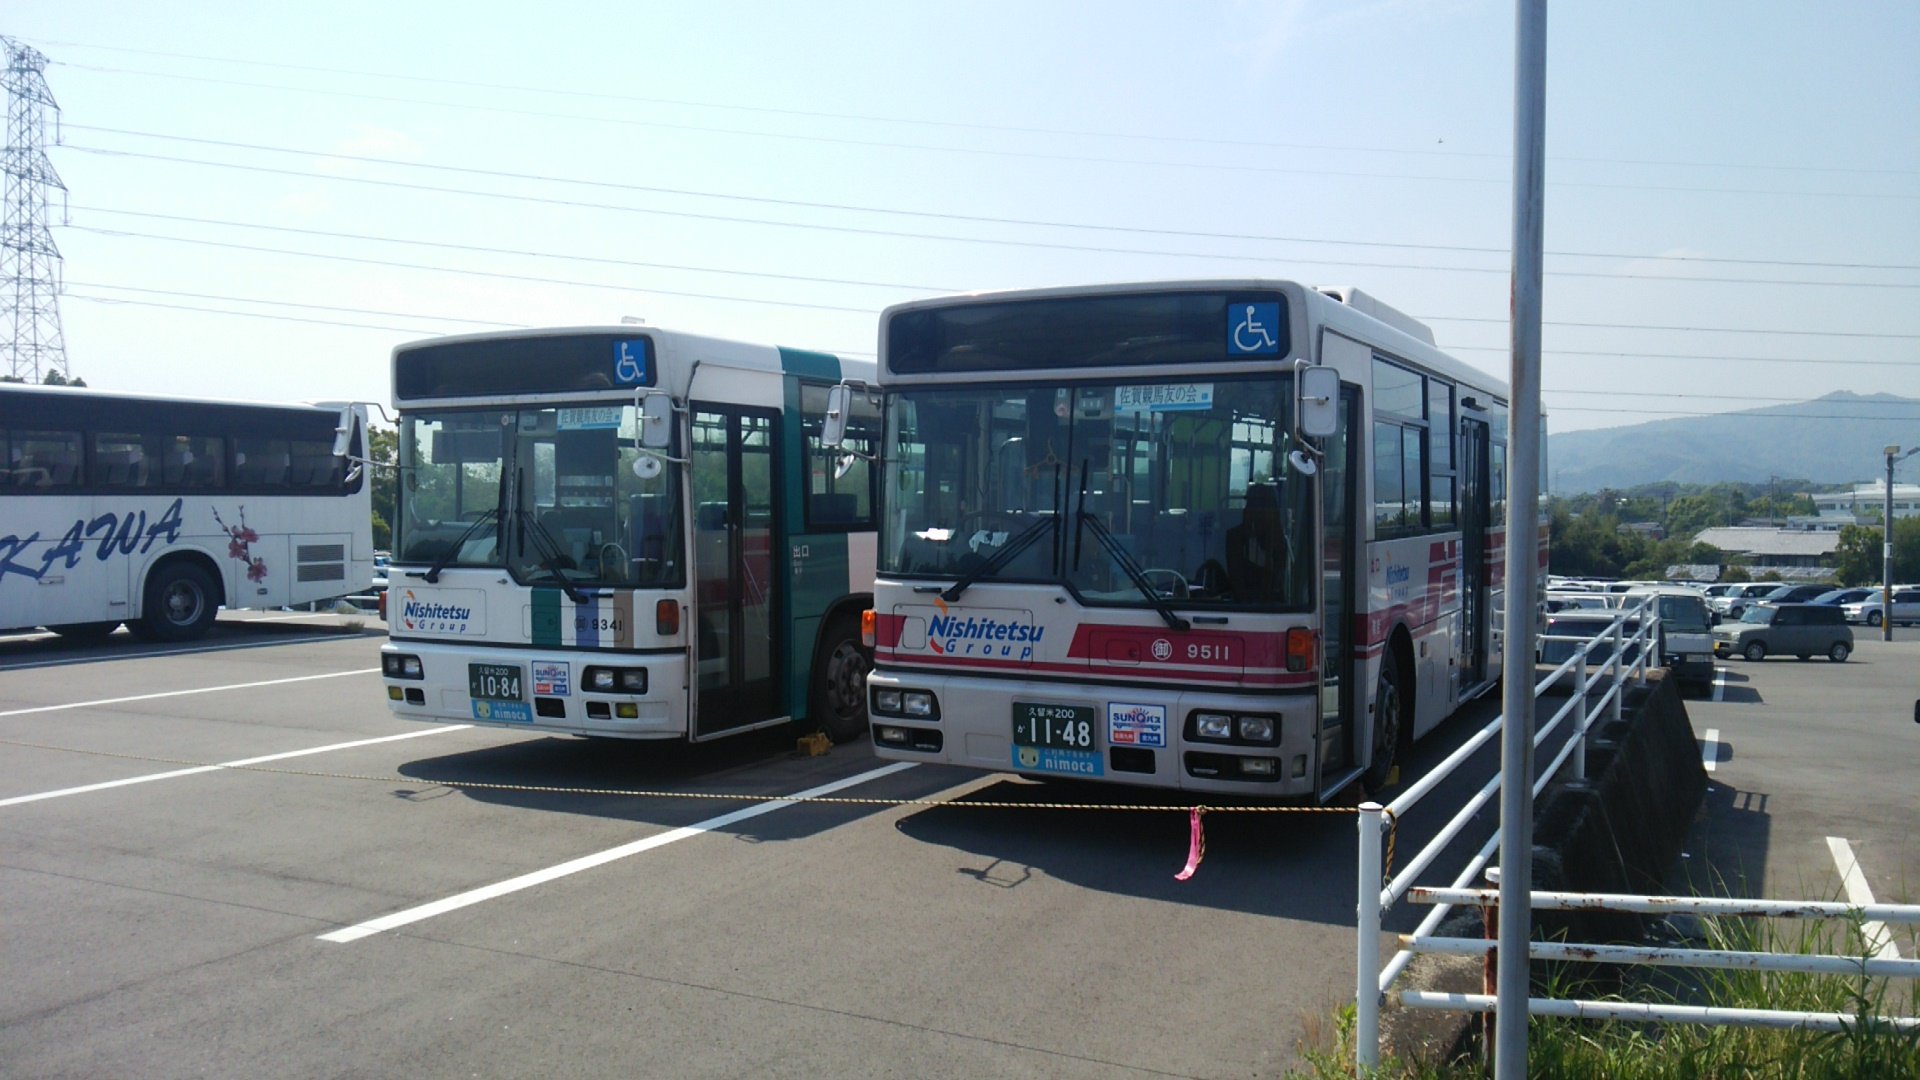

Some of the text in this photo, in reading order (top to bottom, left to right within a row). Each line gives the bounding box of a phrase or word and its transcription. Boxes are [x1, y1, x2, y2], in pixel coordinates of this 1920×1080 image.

[1119, 384, 1197, 405] 佐賀競馬友の会
[404, 600, 471, 621] Nishitetsu
[418, 620, 467, 633] Group
[591, 618, 622, 631] 9341
[927, 614, 1045, 643] Nishitetsu
[945, 637, 1034, 661] Group
[1187, 643, 1229, 661] 9511
[494, 708, 527, 721] nimoca
[1045, 756, 1094, 773] nimoca
